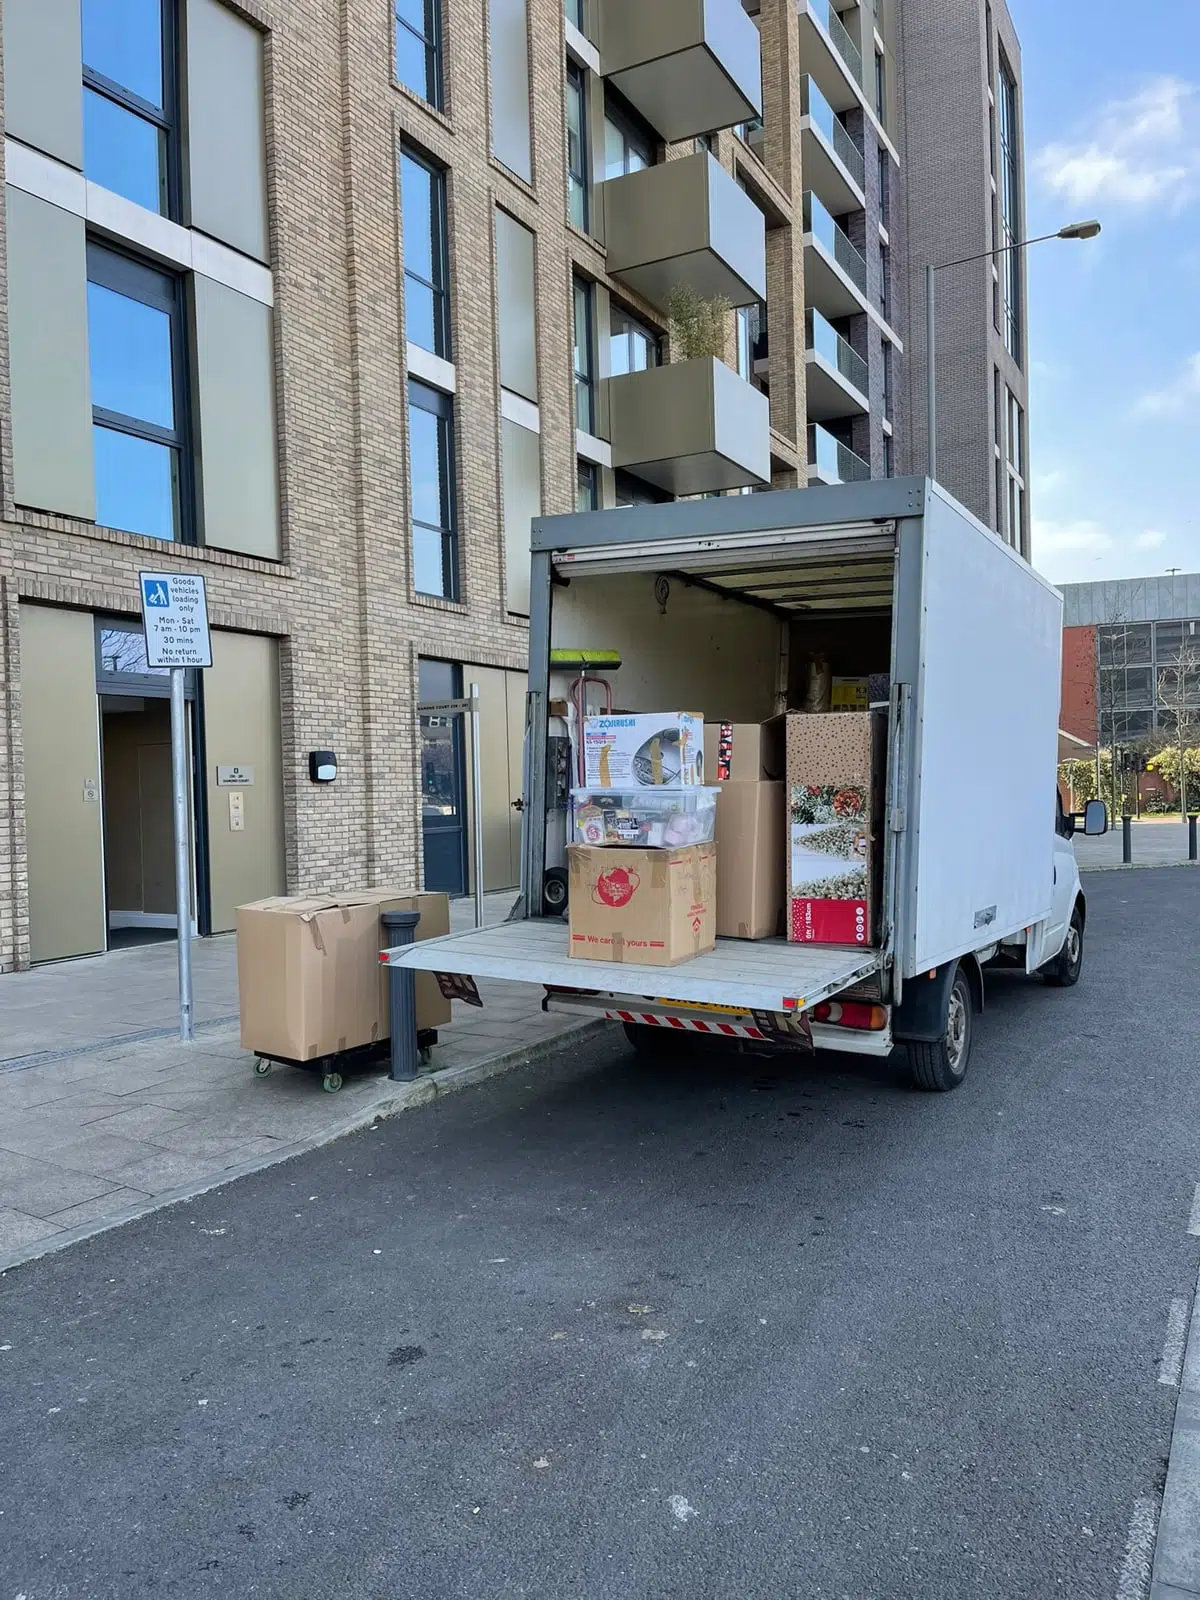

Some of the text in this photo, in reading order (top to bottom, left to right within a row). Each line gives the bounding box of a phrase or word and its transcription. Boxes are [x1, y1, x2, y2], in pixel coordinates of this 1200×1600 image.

[172, 577, 195, 585] Goods
[172, 595, 198, 604] loading
[179, 605, 194, 613] only
[181, 617, 194, 625] Sat
[179, 625, 187, 633] 10
[163, 636, 194, 644] 30 mins
[599, 718, 636, 729] ZOJIRUSHI
[587, 935, 598, 943] We
[600, 937, 615, 945] care
[627, 940, 648, 948] yours
